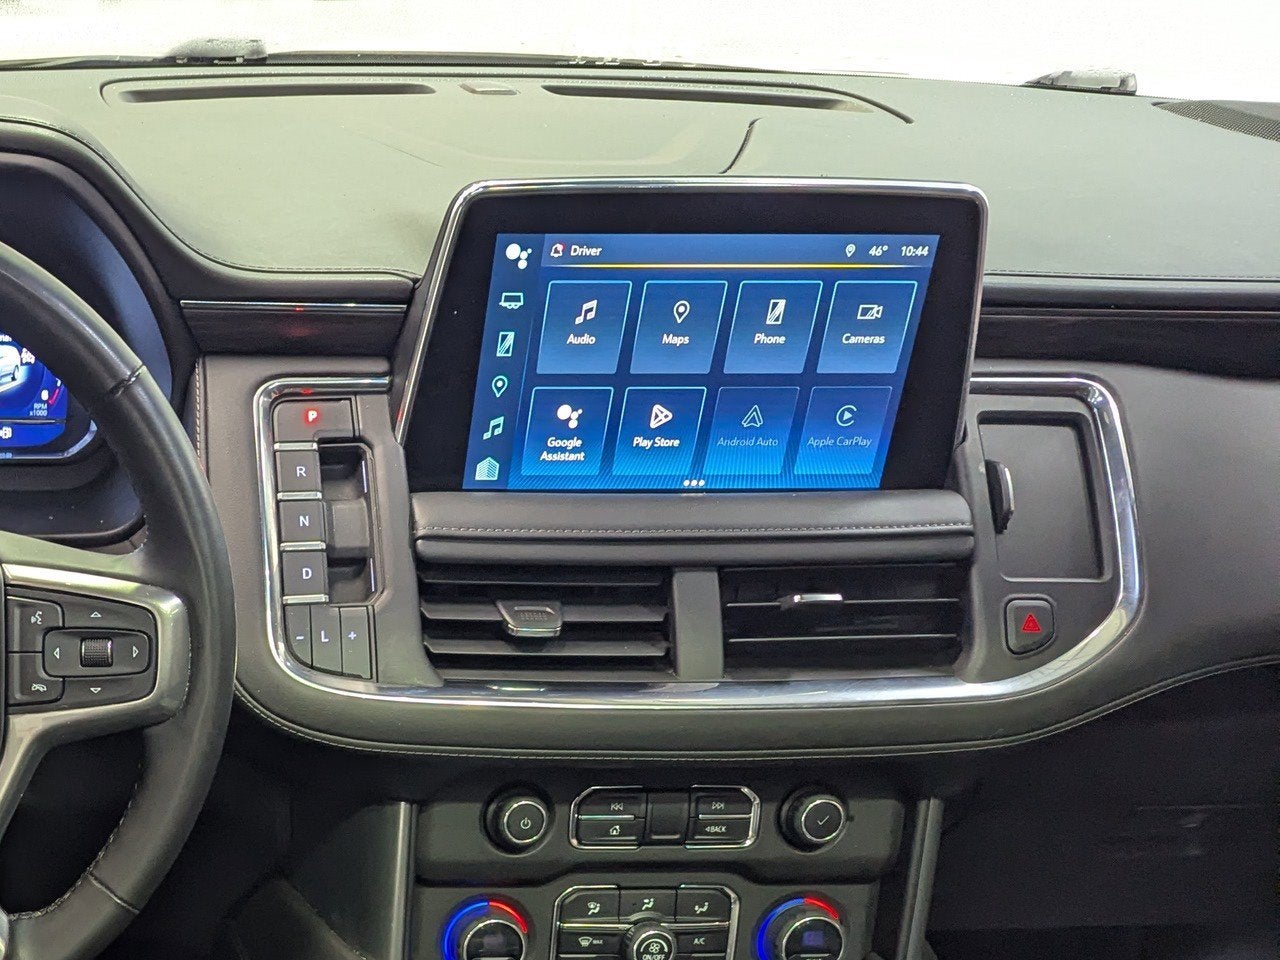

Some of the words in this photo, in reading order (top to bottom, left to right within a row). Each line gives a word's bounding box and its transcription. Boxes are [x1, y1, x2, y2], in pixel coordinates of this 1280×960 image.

[570, 244, 602, 256] Driver
[901, 245, 929, 257] 10:44
[566, 333, 596, 345] Audio
[661, 333, 690, 347] Maps
[754, 333, 786, 345] Phone
[842, 333, 885, 345] Cameras
[307, 410, 318, 421] P
[547, 436, 582, 449] Google
[633, 436, 653, 450] Play
[653, 436, 680, 447] Store
[717, 436, 755, 447] Android
[757, 437, 779, 447] Auto
[807, 436, 835, 448] Apple
[836, 436, 872, 448] CarPlay
[540, 450, 585, 461] Assistant
[297, 466, 307, 477] R
[299, 516, 310, 527] N
[302, 568, 312, 579] D
[321, 630, 329, 642] L
[709, 825, 727, 833] BACK
